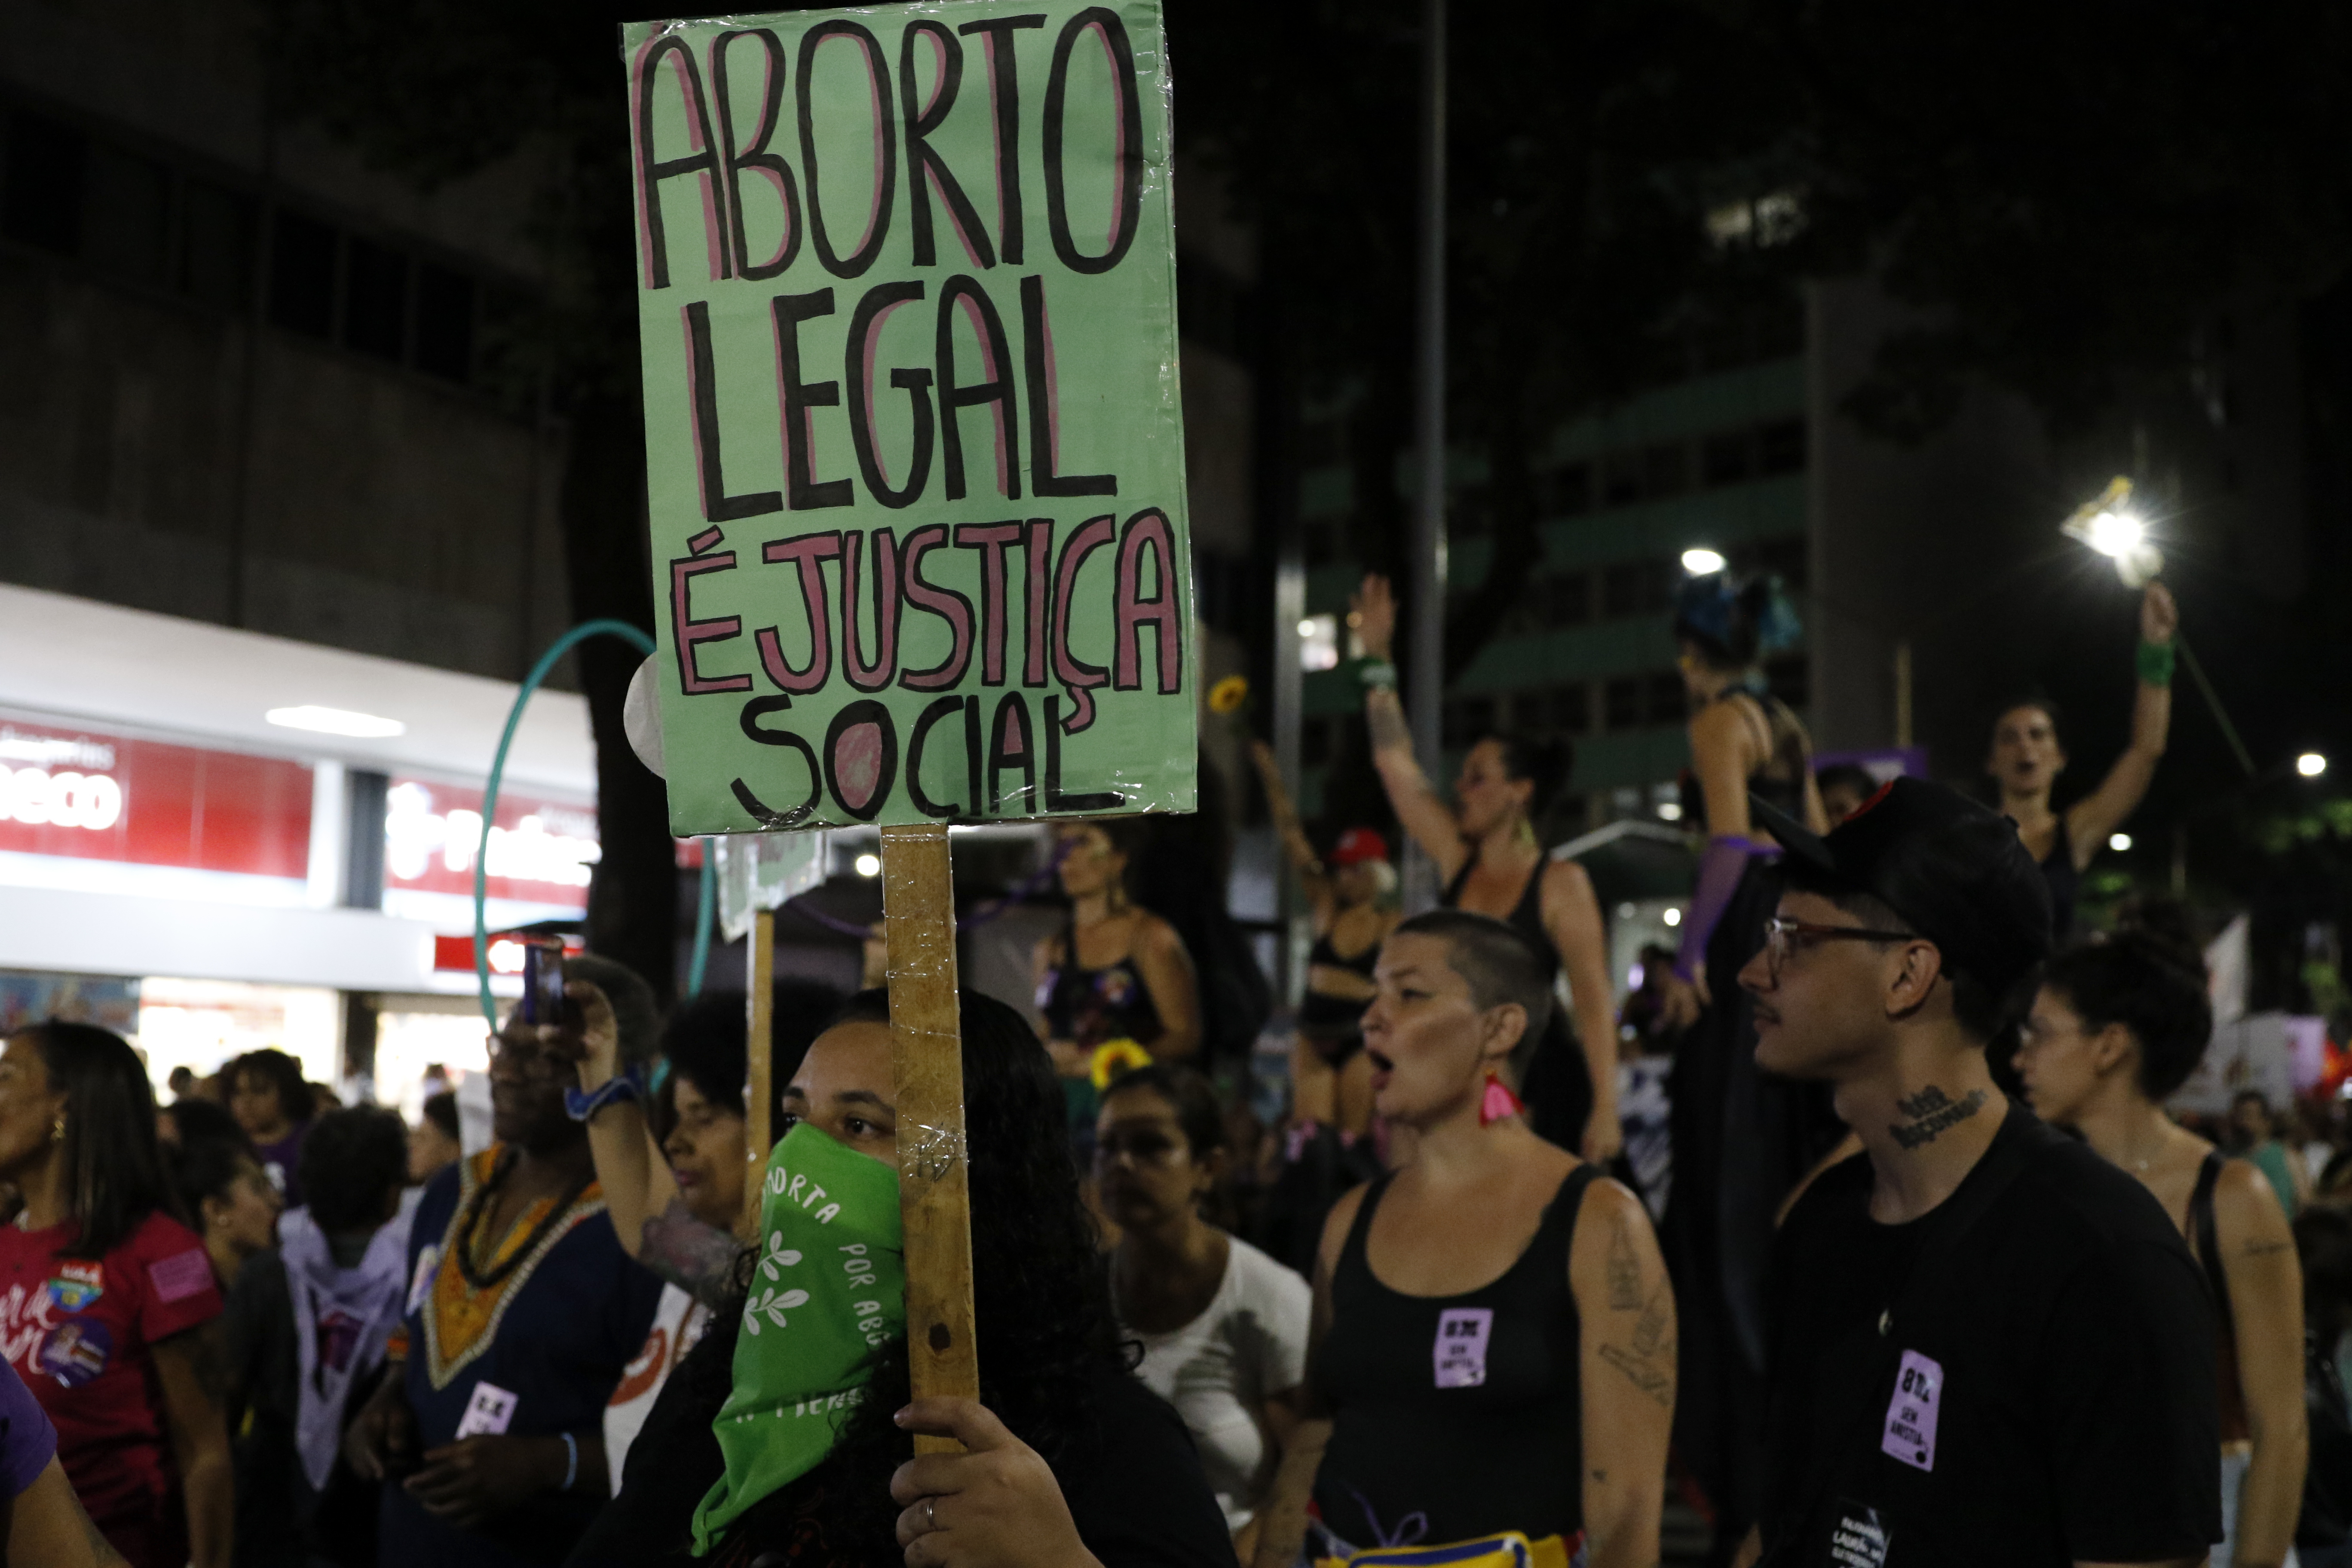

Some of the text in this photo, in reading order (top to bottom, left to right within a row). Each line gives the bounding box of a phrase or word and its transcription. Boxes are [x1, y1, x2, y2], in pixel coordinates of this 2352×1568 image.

[632, 6, 1142, 290] ABORTO
[681, 274, 1117, 522] LEGAL
[670, 507, 1182, 735] É JUSTIÇA
[730, 690, 1126, 828] SOCIAL
[838, 1243, 876, 1289] POR
